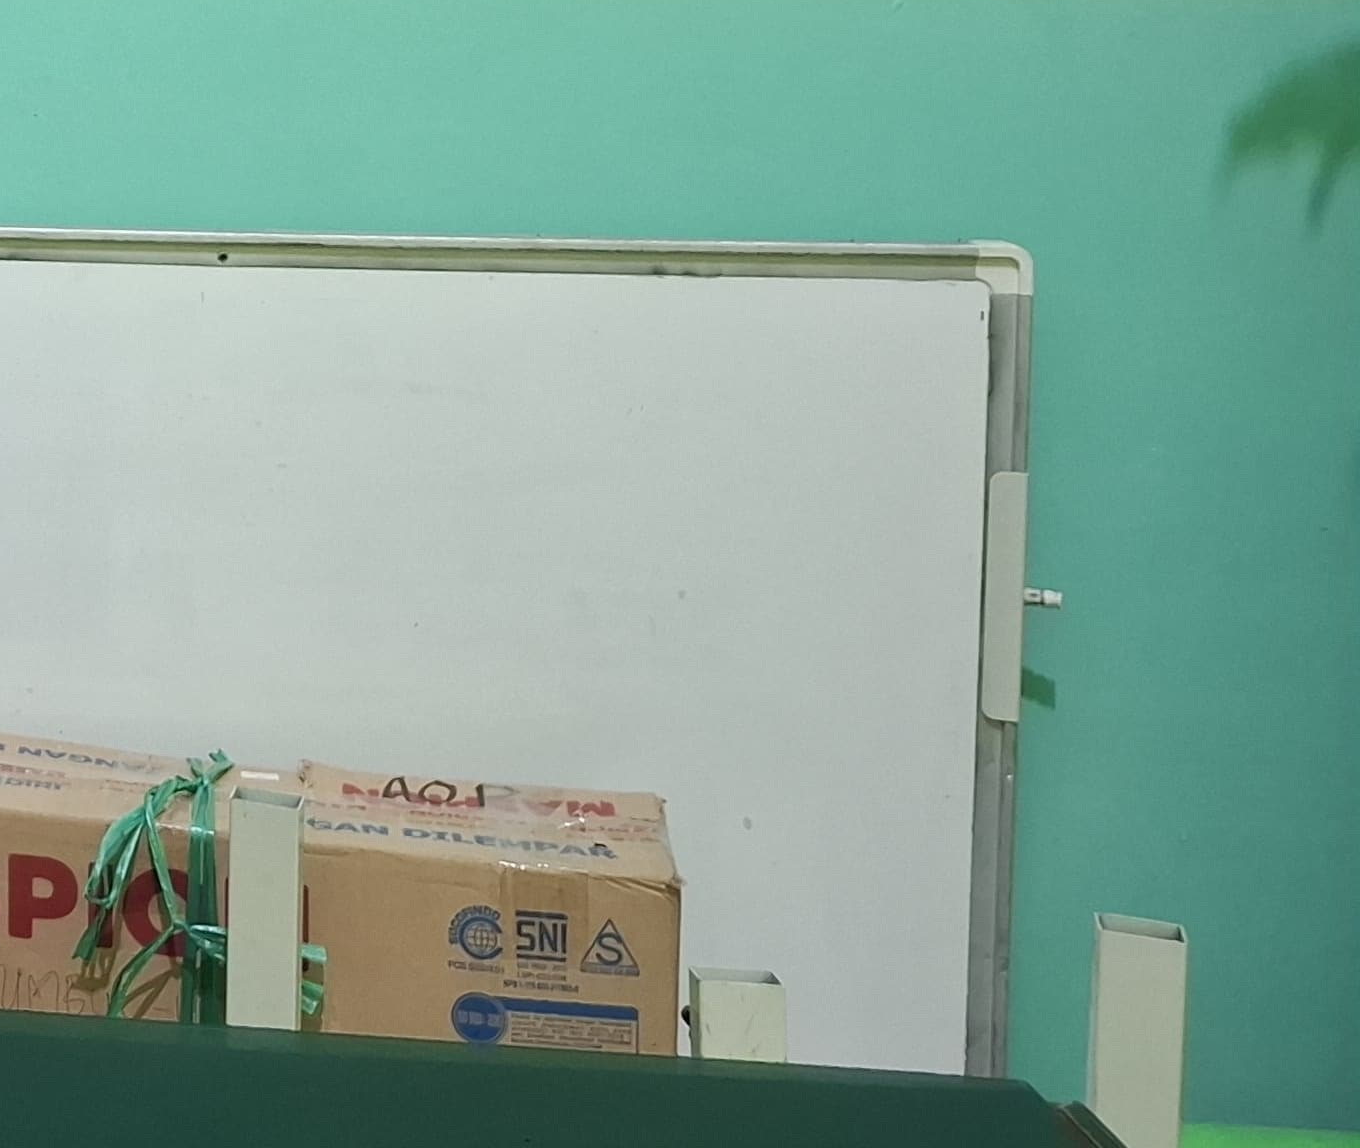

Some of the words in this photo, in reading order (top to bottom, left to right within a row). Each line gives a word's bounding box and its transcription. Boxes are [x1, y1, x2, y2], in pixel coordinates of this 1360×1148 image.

[306, 817, 389, 837] GAN
[402, 827, 618, 860] DILEMPAR
[516, 919, 568, 955] SNI
